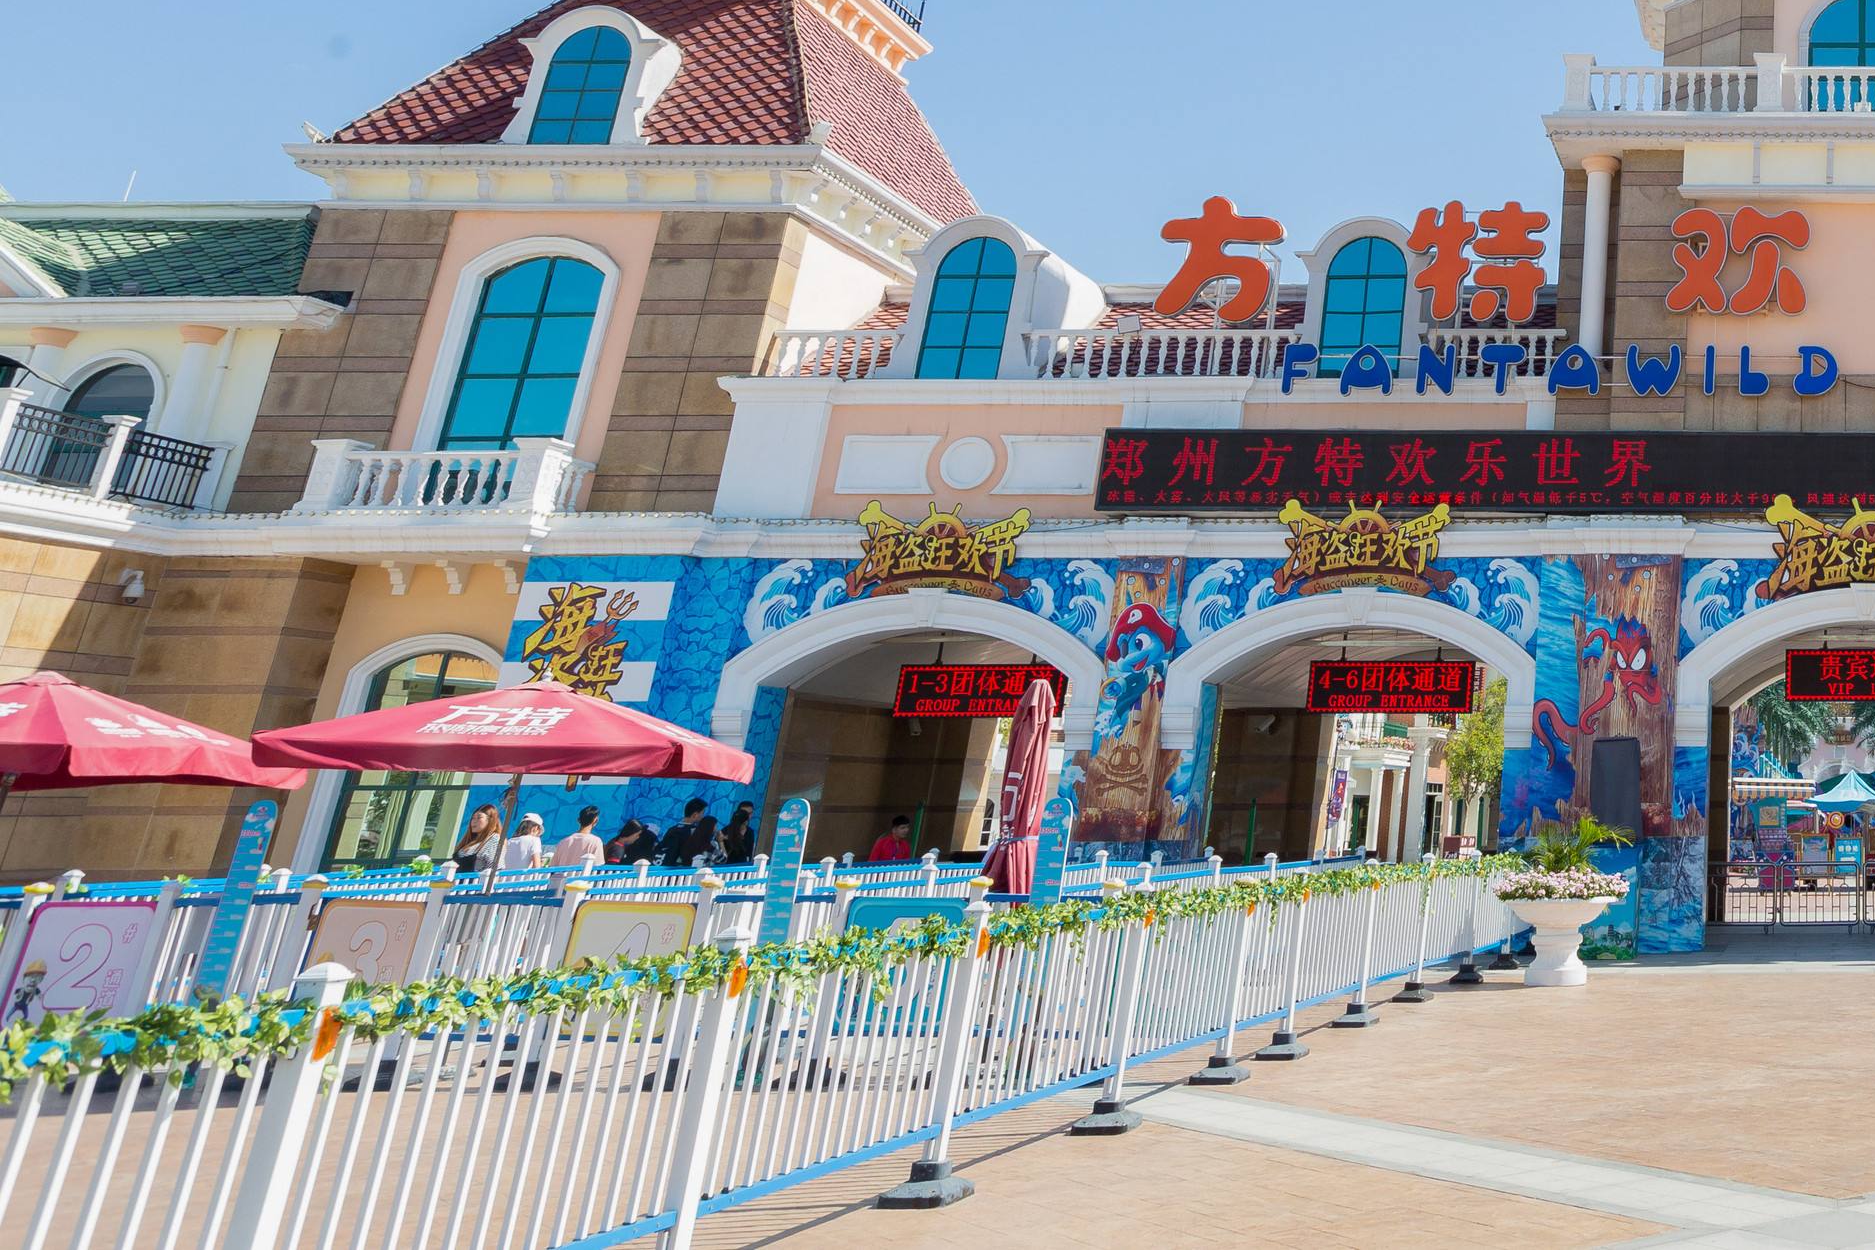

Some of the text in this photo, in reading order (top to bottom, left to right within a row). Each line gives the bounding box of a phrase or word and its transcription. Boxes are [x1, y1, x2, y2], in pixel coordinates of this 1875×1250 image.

[1280, 342, 1840, 397] FANTAWILD
[1102, 436, 1651, 488] 郑州方特欢乐世界
[855, 521, 1024, 589] 海盗狂欢节
[1283, 515, 1446, 584] 海盗狂欢节
[1313, 575, 1372, 593] Buccaneer
[1318, 666, 1462, 692] 4-6团体通道
[1827, 682, 1855, 695] VIP
[916, 699, 1020, 711] GROUP ENTRAN
[1328, 694, 1449, 707] GROUP ENTRANCE
[431, 704, 575, 727] 方特
